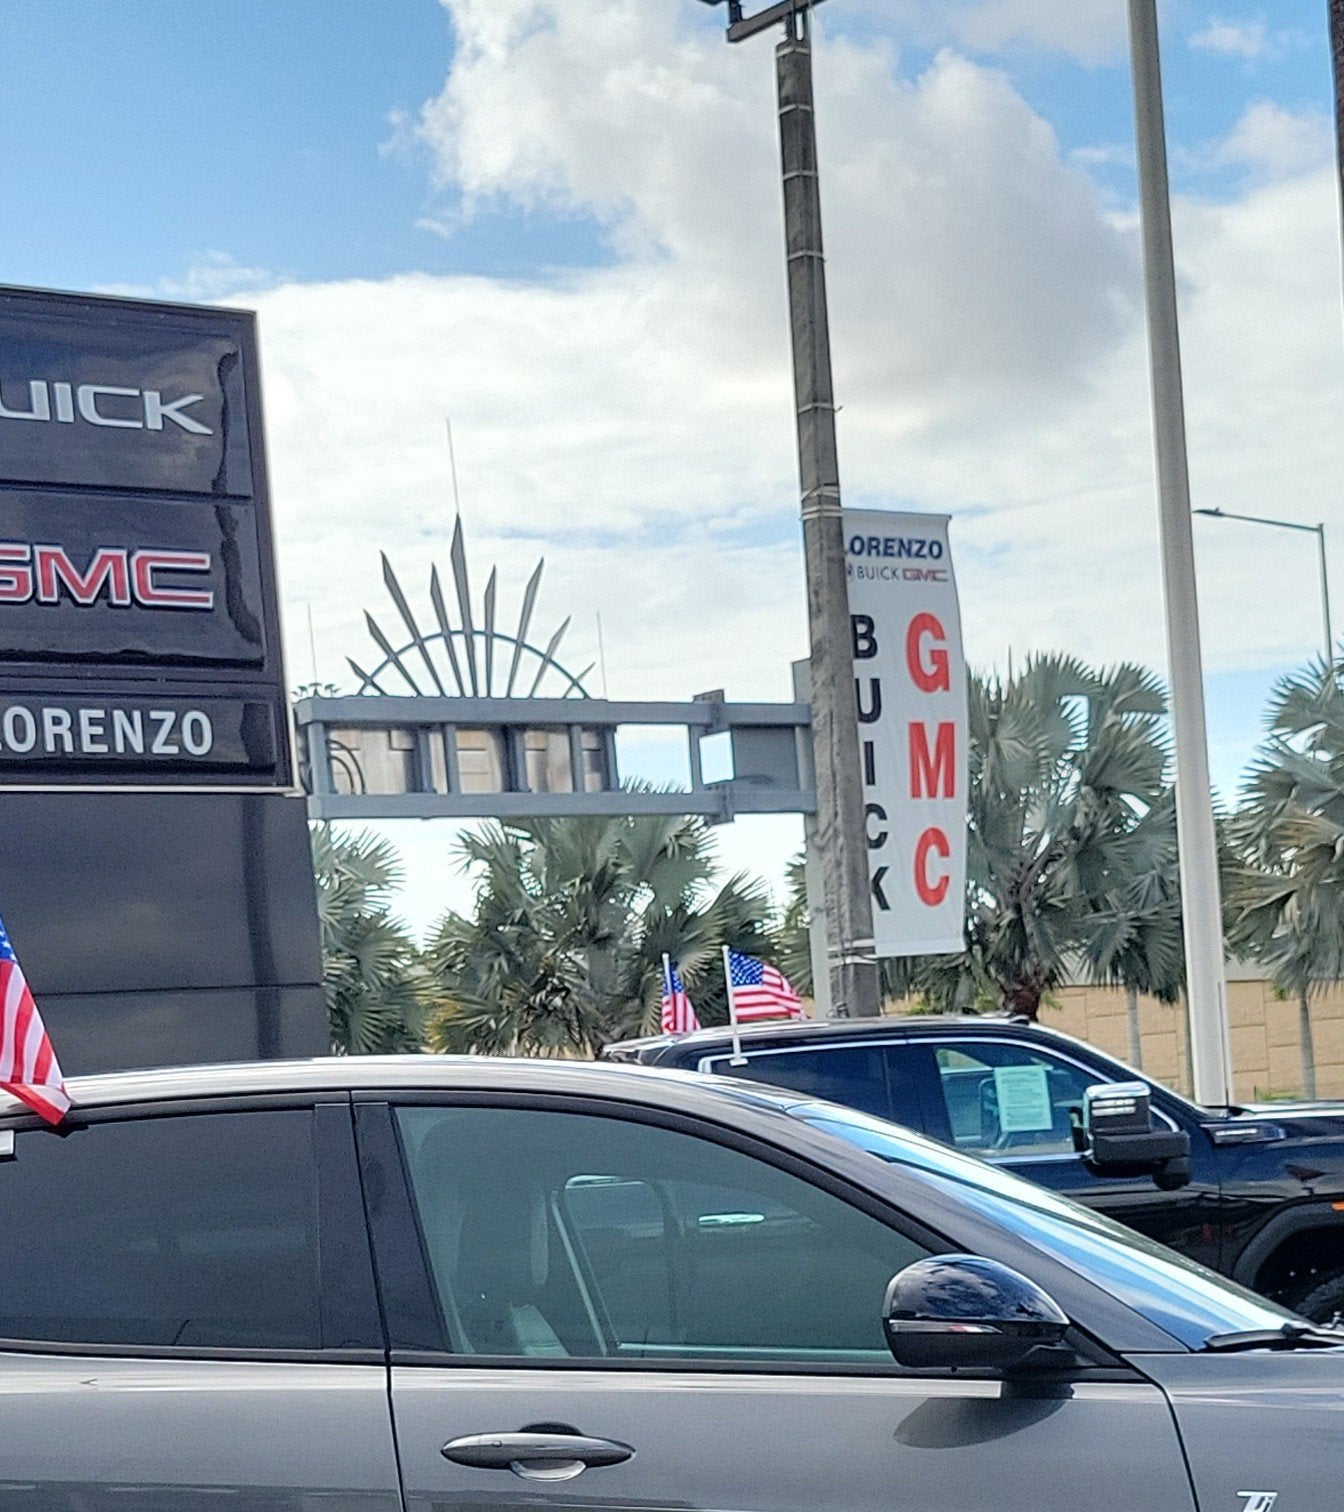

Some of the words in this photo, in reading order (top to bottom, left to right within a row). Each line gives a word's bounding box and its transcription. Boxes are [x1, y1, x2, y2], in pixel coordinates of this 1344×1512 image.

[845, 535, 943, 560] ORENZO
[857, 566, 899, 581] BUICK
[902, 568, 949, 582] GMC
[851, 614, 891, 912] BUICK
[905, 612, 956, 908] GMC
